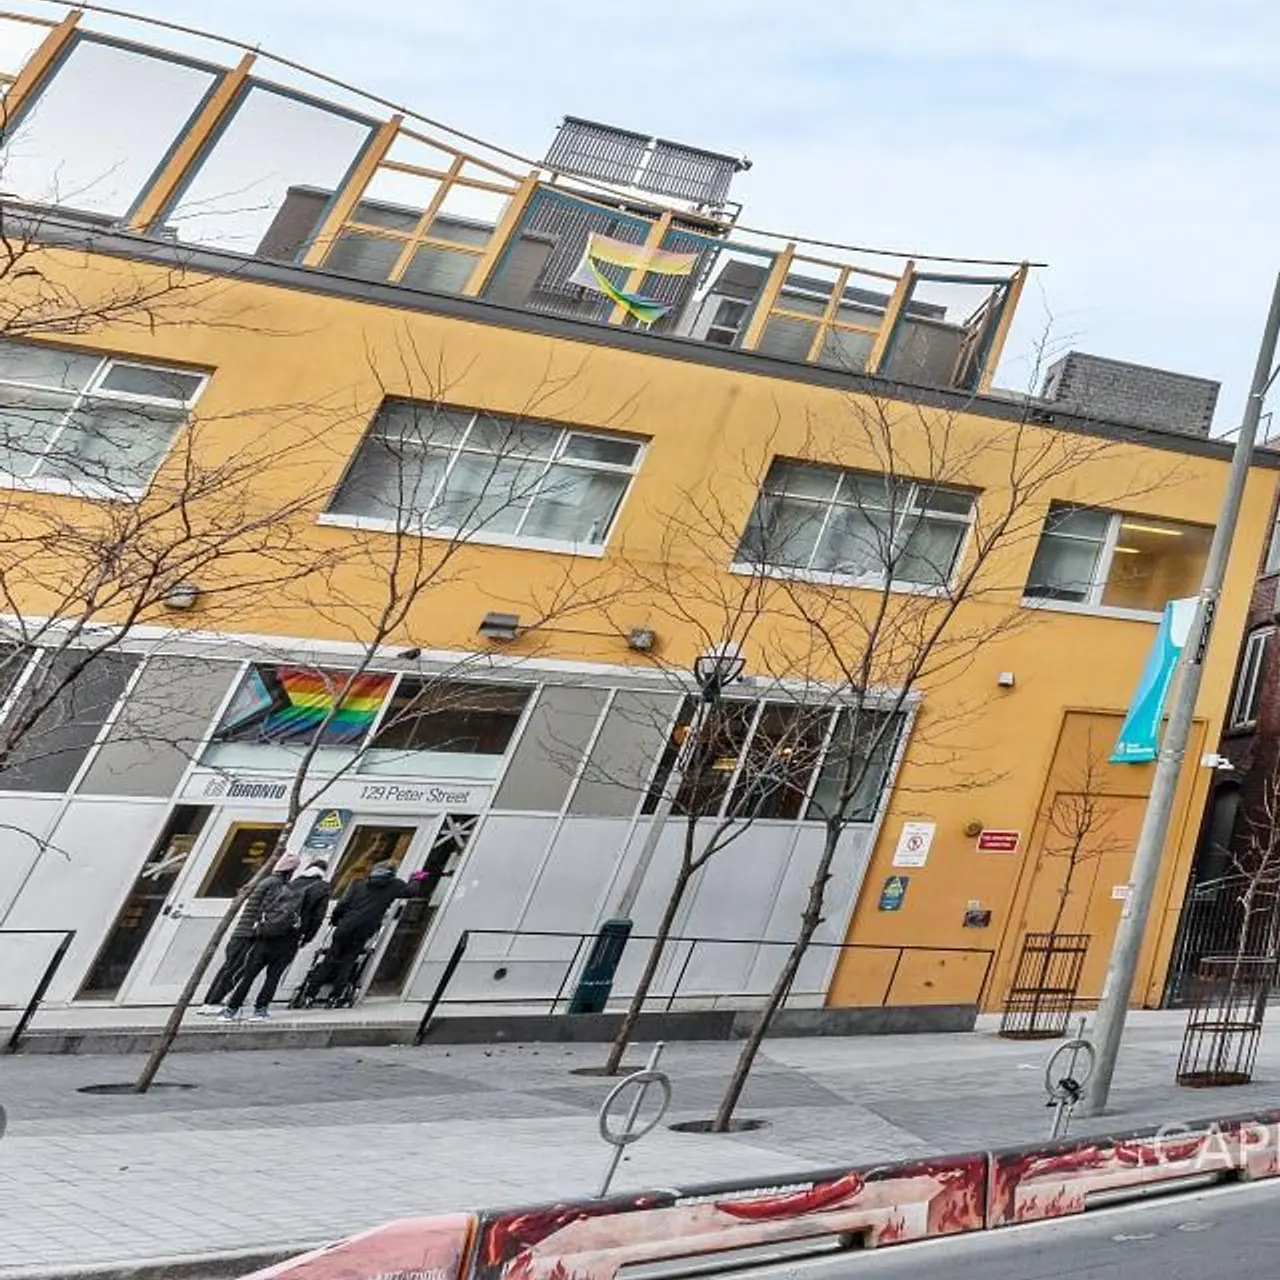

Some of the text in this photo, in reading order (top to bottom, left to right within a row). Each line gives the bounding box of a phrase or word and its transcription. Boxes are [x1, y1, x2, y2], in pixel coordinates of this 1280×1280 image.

[360, 786, 470, 803] 129 Peter Street
